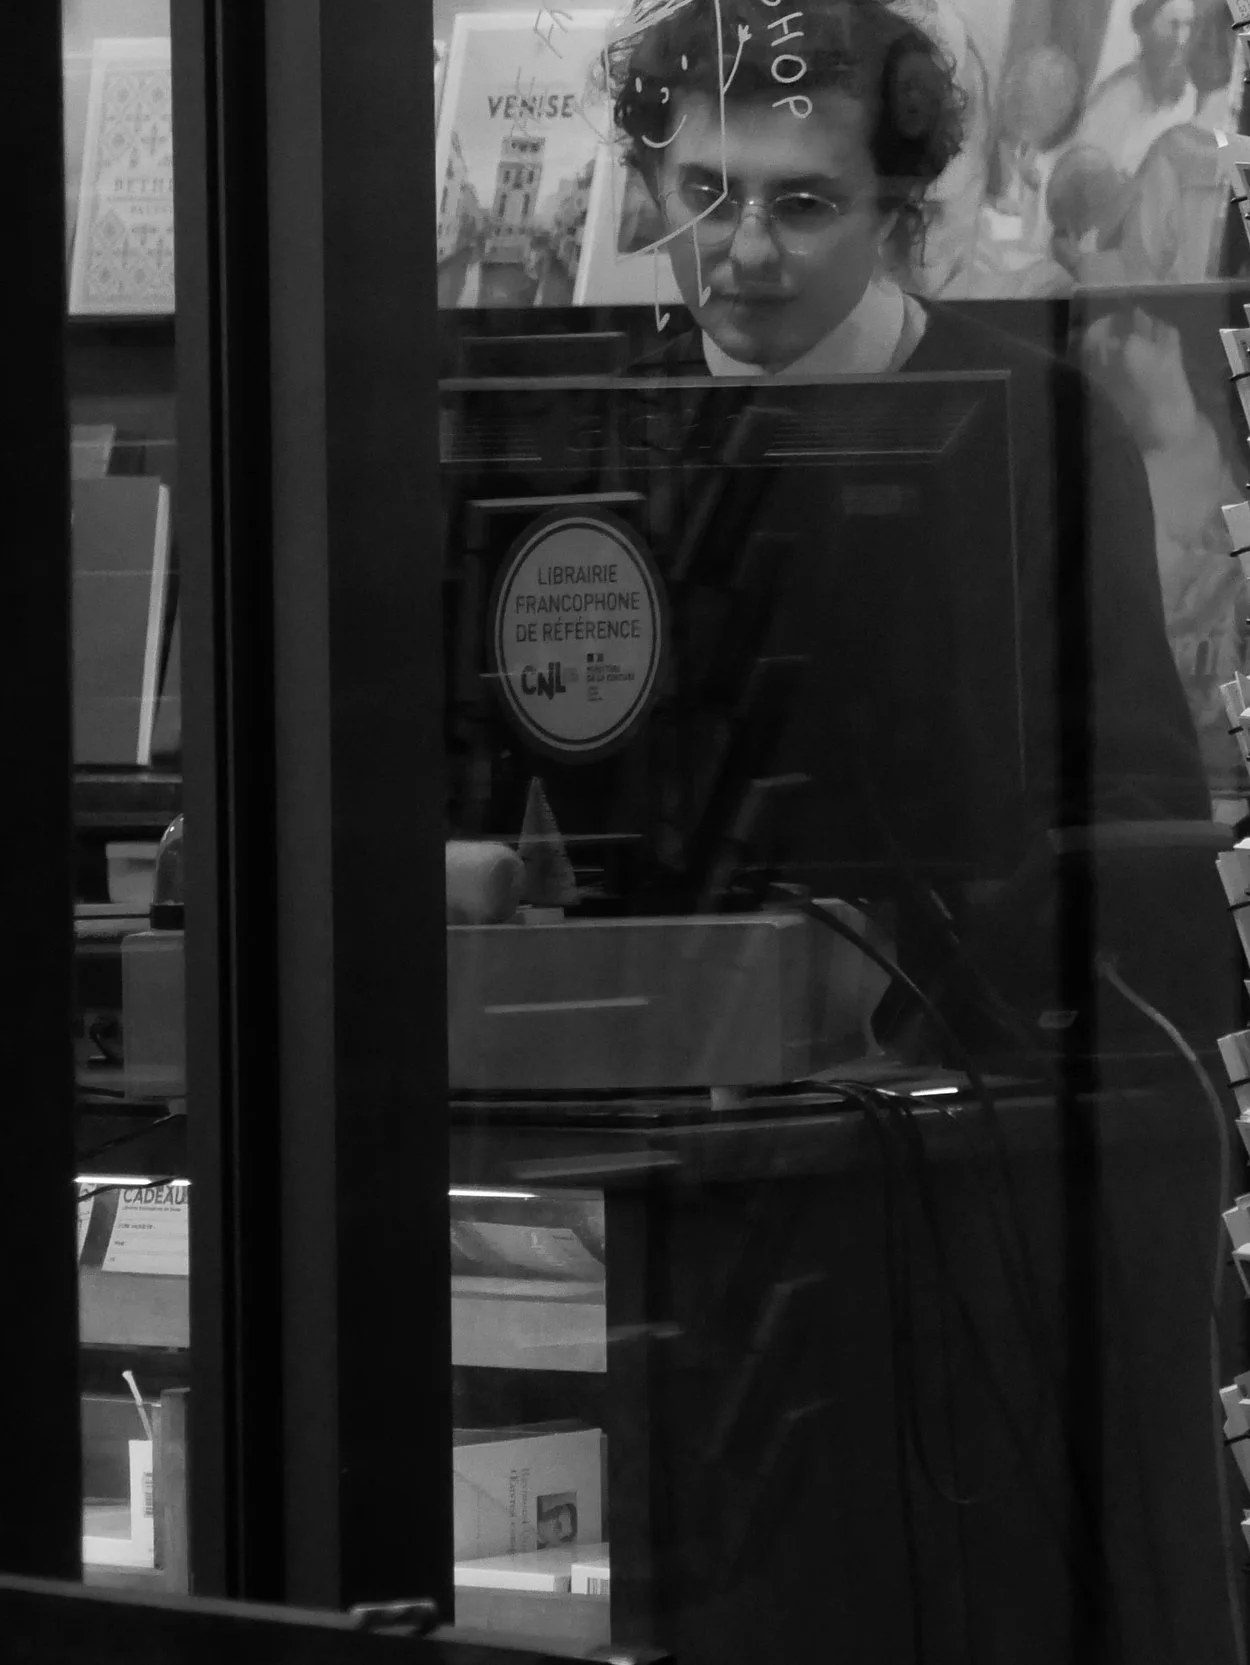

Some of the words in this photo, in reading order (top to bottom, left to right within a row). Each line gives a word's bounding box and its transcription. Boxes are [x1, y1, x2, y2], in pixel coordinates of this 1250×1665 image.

[486, 94, 576, 120] VENISE
[537, 564, 619, 586] LIBRAIRIE
[515, 591, 641, 614] FRANCOPHONE
[515, 623, 538, 643] DE
[542, 615, 641, 642] RÉFÉRENCE
[521, 661, 567, 701] CNL
[123, 1185, 185, 1205] CADEAU
